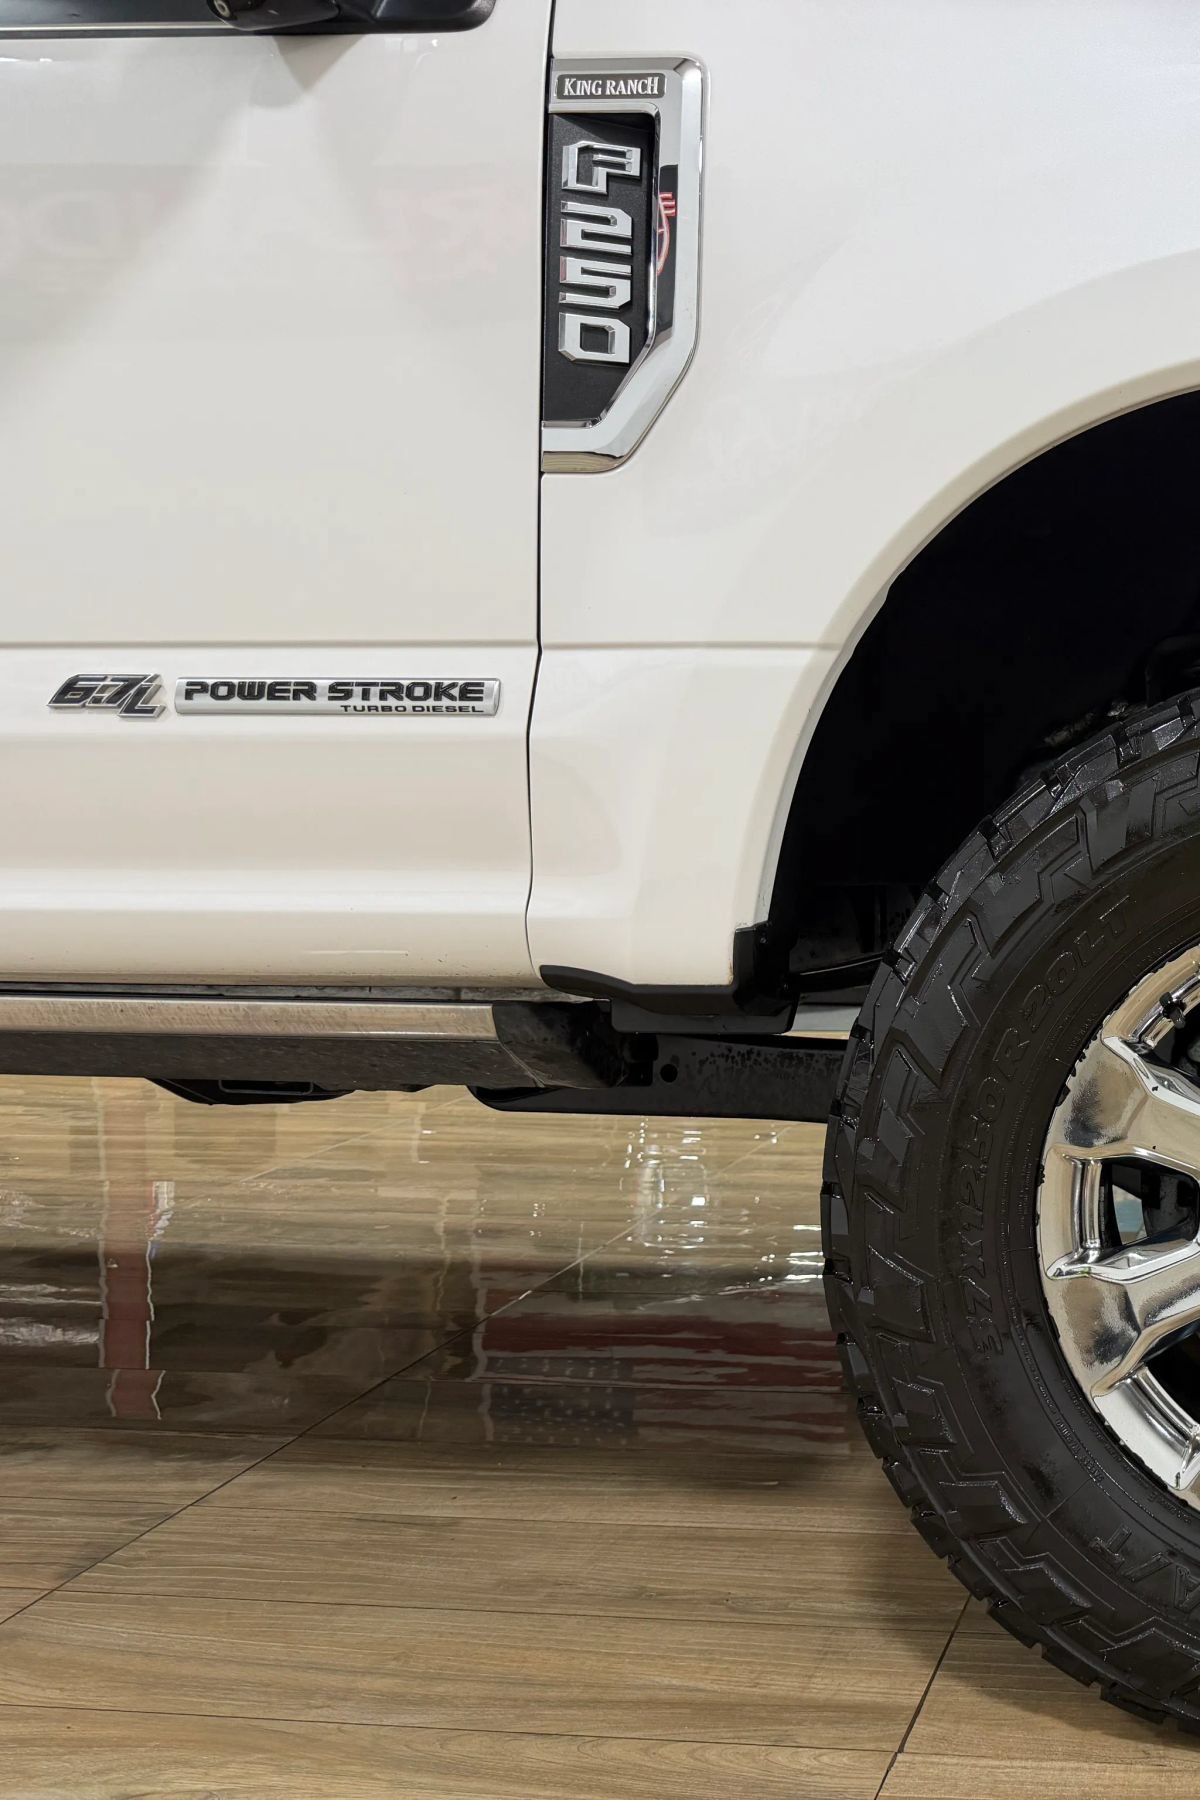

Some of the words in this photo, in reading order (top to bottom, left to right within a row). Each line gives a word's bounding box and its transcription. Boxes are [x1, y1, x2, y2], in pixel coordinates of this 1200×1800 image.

[562, 77, 602, 96] KING
[605, 76, 660, 95] RANCH
[185, 680, 317, 702] POWER
[327, 680, 485, 702] STROKE
[340, 705, 407, 714] TURBO
[411, 705, 485, 714] DIESEL
